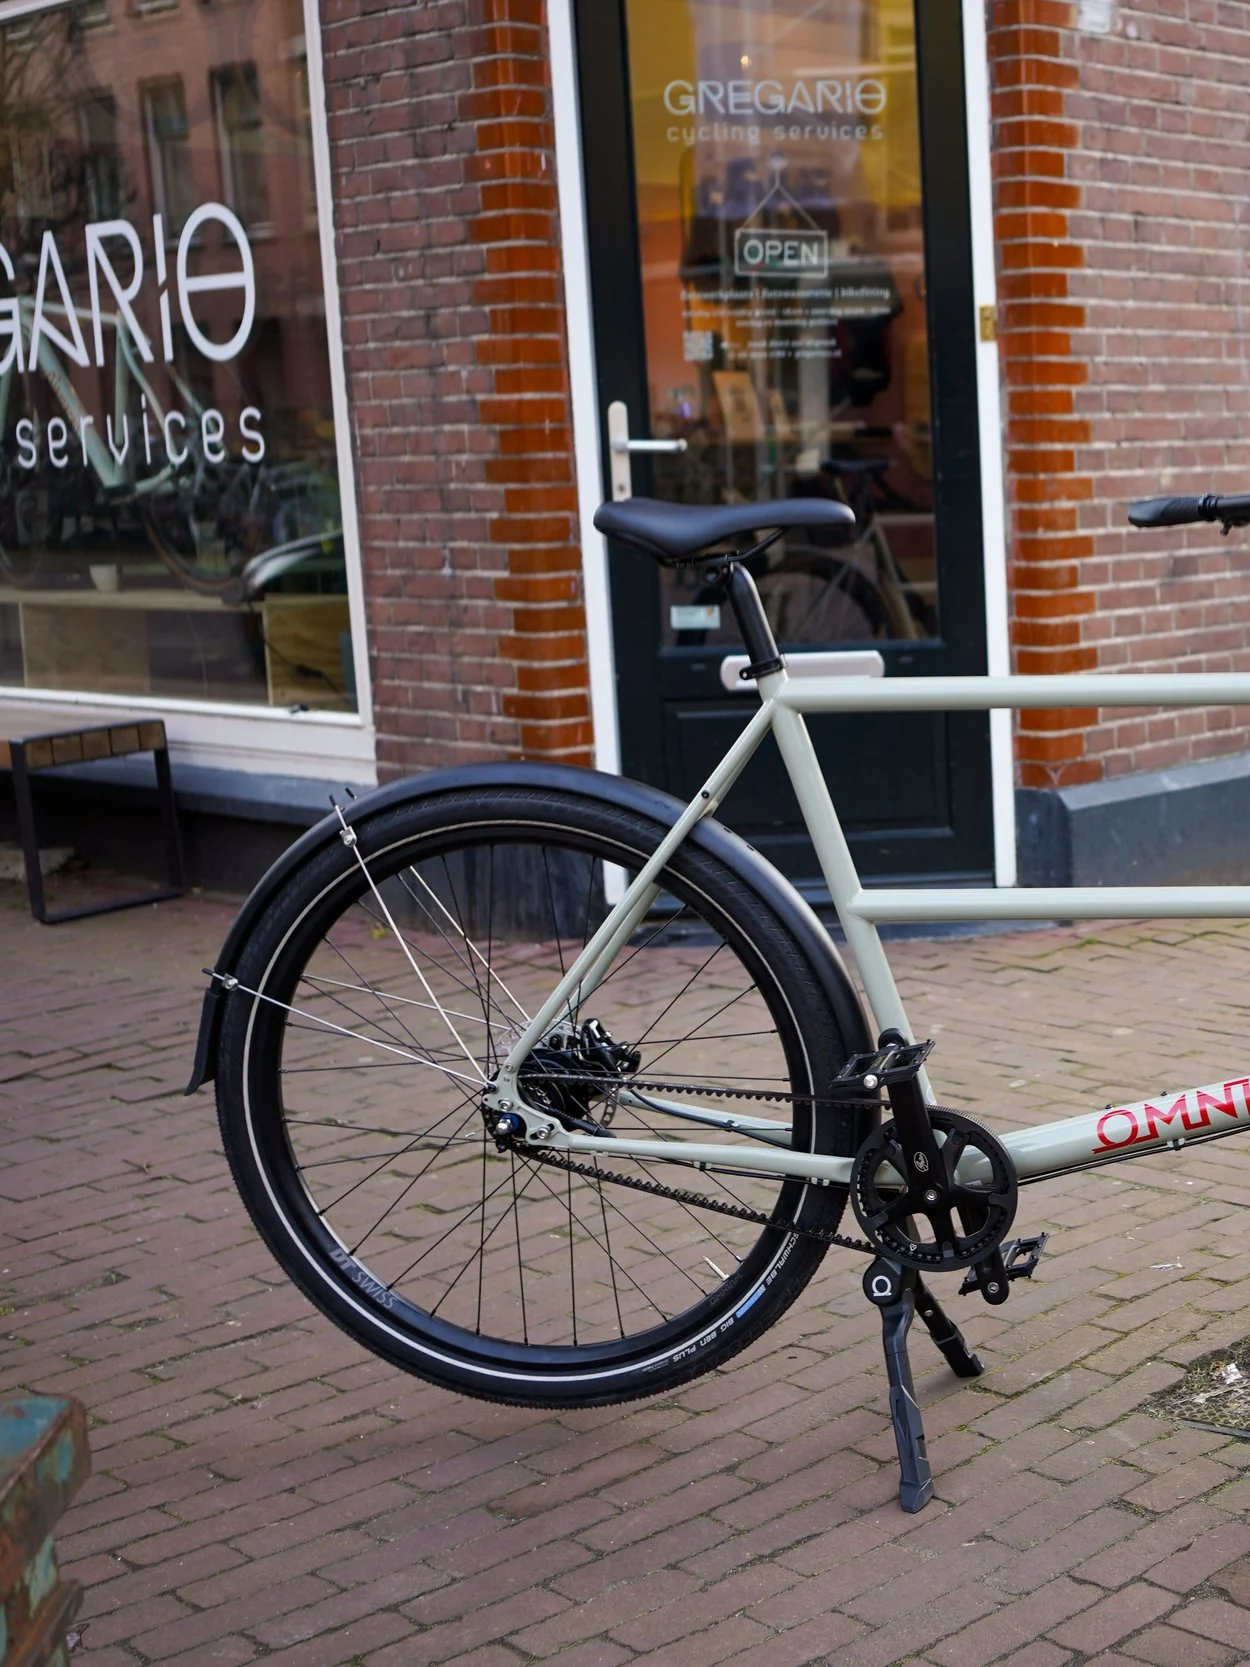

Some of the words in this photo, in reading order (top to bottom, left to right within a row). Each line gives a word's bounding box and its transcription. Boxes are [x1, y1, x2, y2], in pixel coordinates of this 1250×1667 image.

[664, 79, 887, 116] GREGARIO
[667, 122, 761, 146] cycling
[773, 121, 884, 142] services
[743, 238, 820, 266] OPEN
[16, 393, 266, 470] services
[765, 1232, 800, 1286] SCHWALBE
[329, 1249, 358, 1271] DT
[351, 1271, 398, 1309] SWISS
[720, 1317, 735, 1333] BIG
[672, 1344, 697, 1363] PLUS
